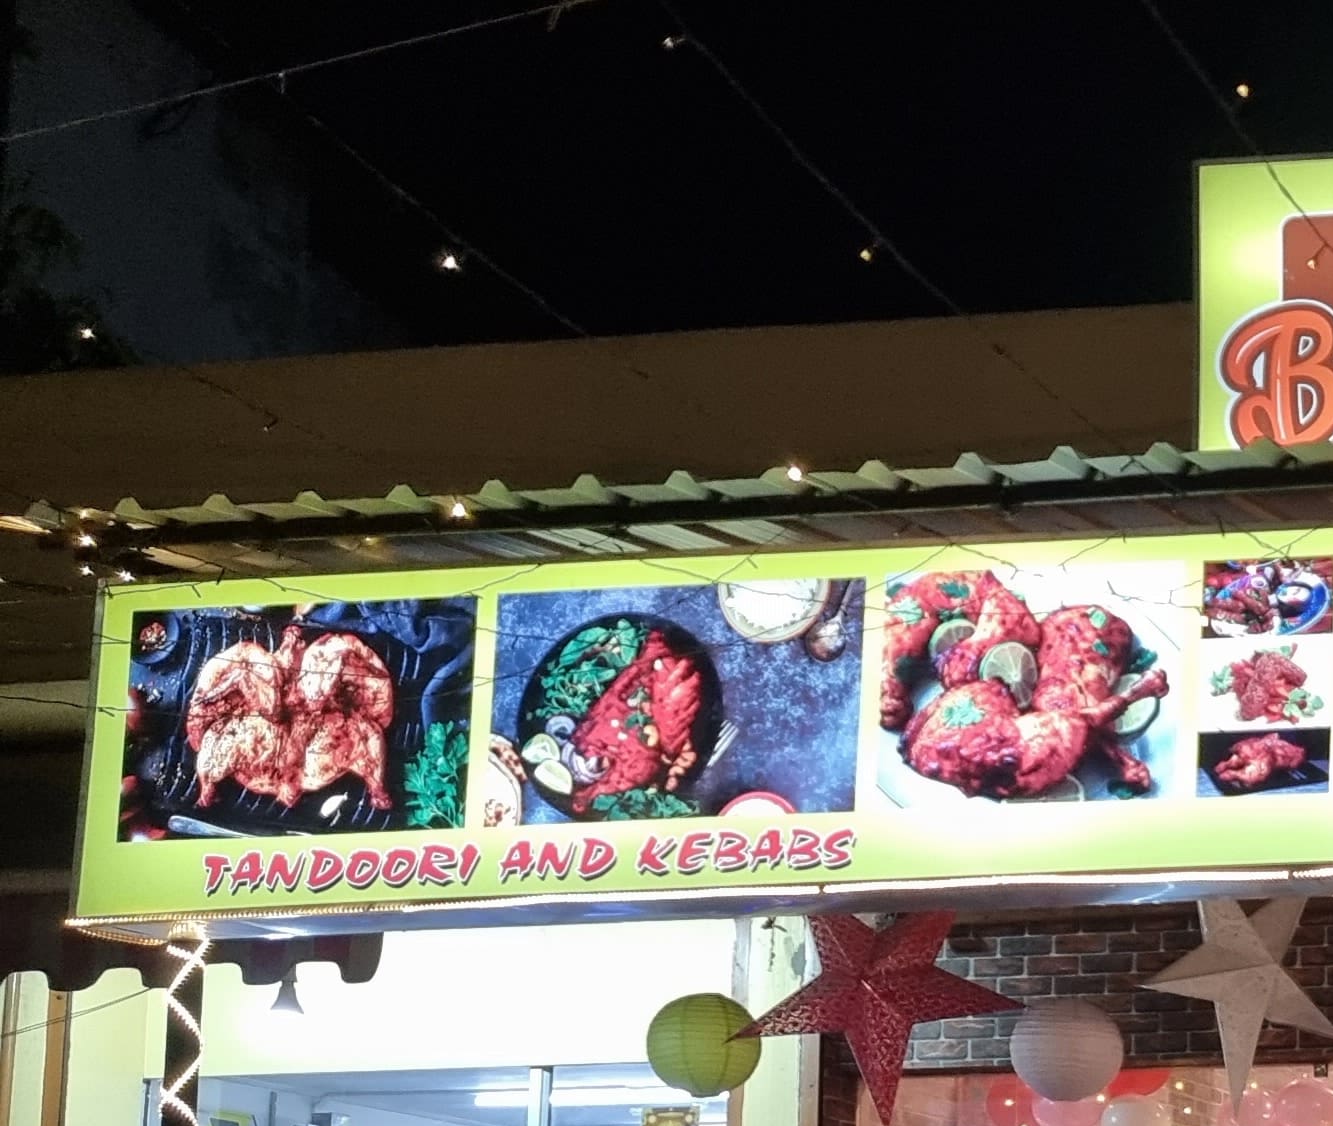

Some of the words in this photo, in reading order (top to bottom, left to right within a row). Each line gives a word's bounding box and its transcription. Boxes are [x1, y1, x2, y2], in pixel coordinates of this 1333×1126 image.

[203, 844, 480, 894] TANDOORI
[499, 838, 618, 881] AND
[636, 827, 859, 876] KEBABS
